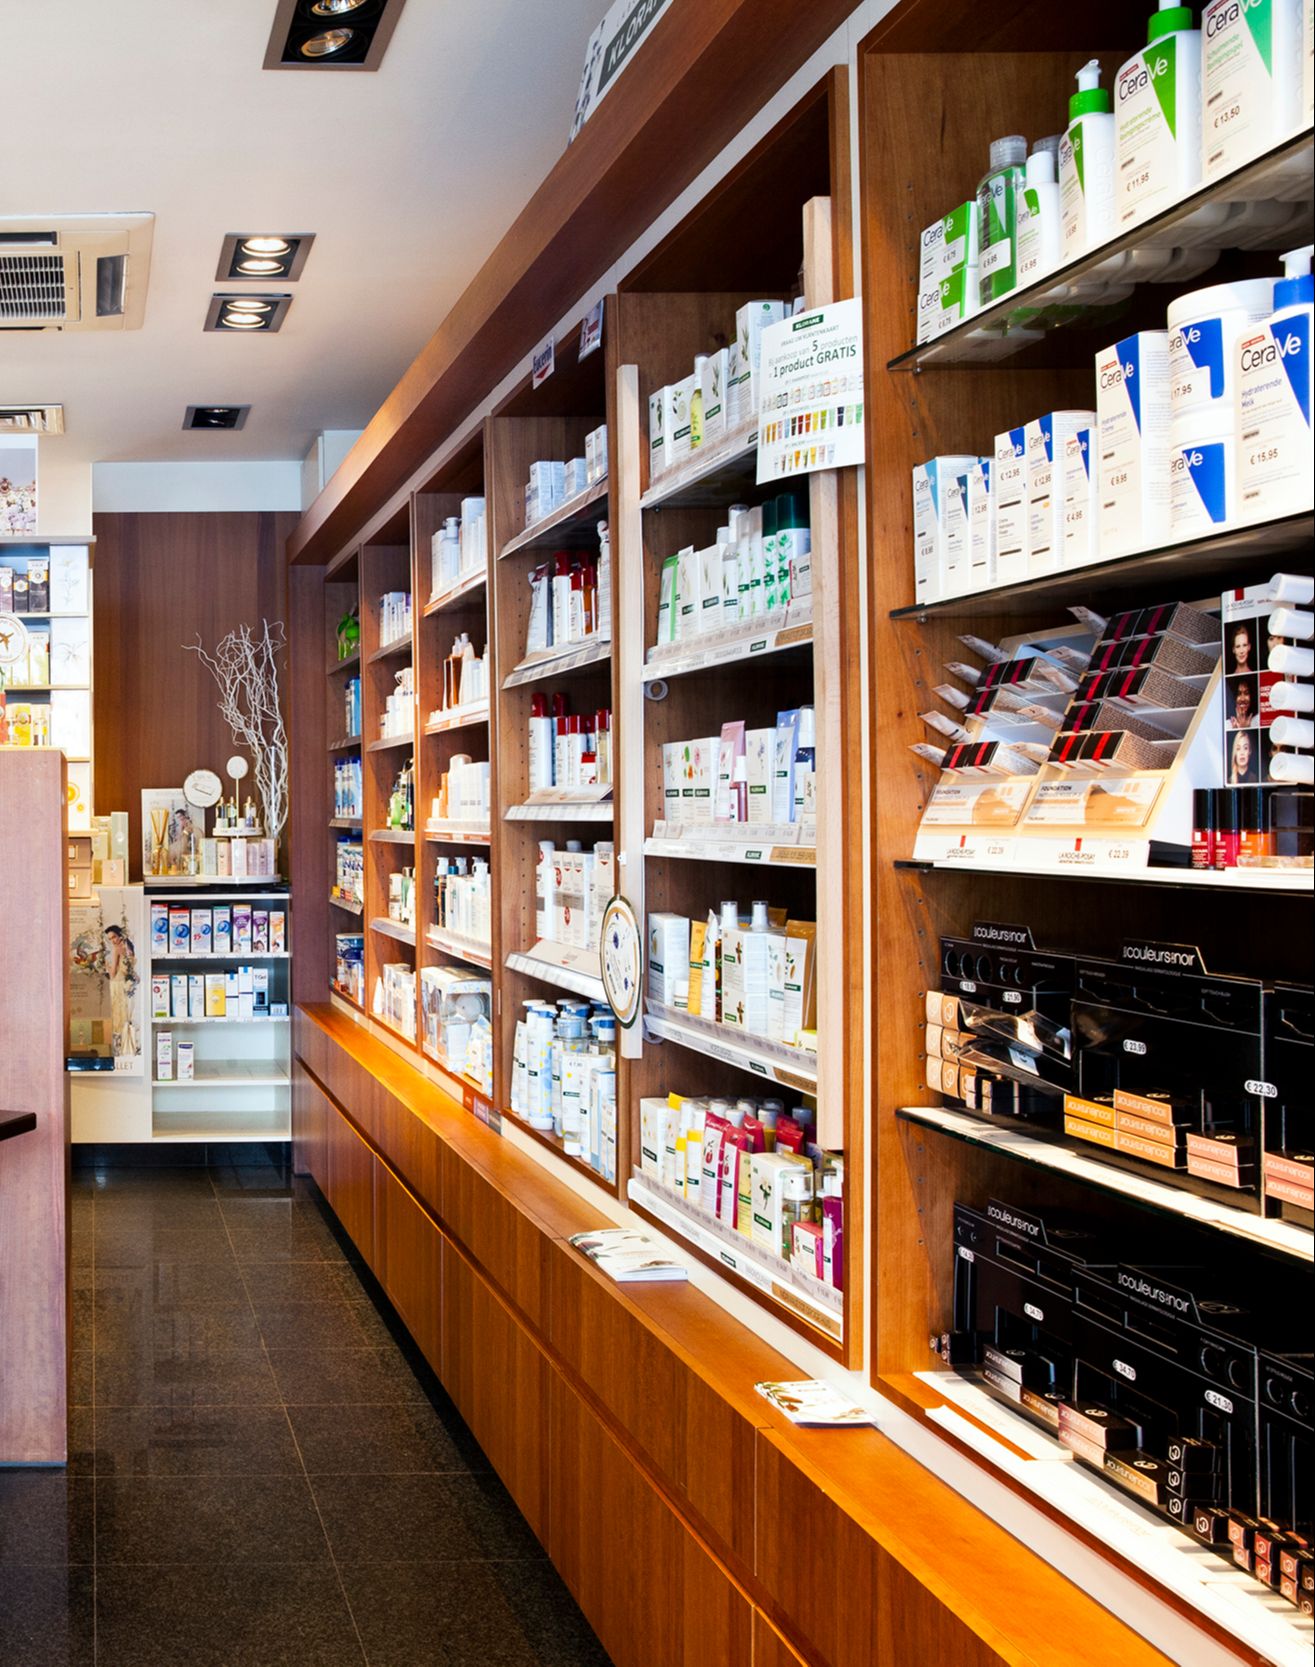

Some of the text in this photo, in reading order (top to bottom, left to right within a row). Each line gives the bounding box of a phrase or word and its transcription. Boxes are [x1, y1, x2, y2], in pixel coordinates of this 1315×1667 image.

[1119, 56, 1168, 101] CeraVe
[923, 217, 954, 247] CeraVe
[919, 282, 950, 310] CeraVe
[812, 340, 818, 352] 5
[820, 335, 858, 351] producten
[1170, 328, 1202, 352] eraVe
[1240, 333, 1302, 372] CeraVe
[779, 355, 814, 377] product
[816, 344, 857, 365] GRATIS
[1100, 362, 1135, 389] CeraVe
[997, 444, 1023, 461] CeraVe
[1171, 450, 1204, 473] eraVe
